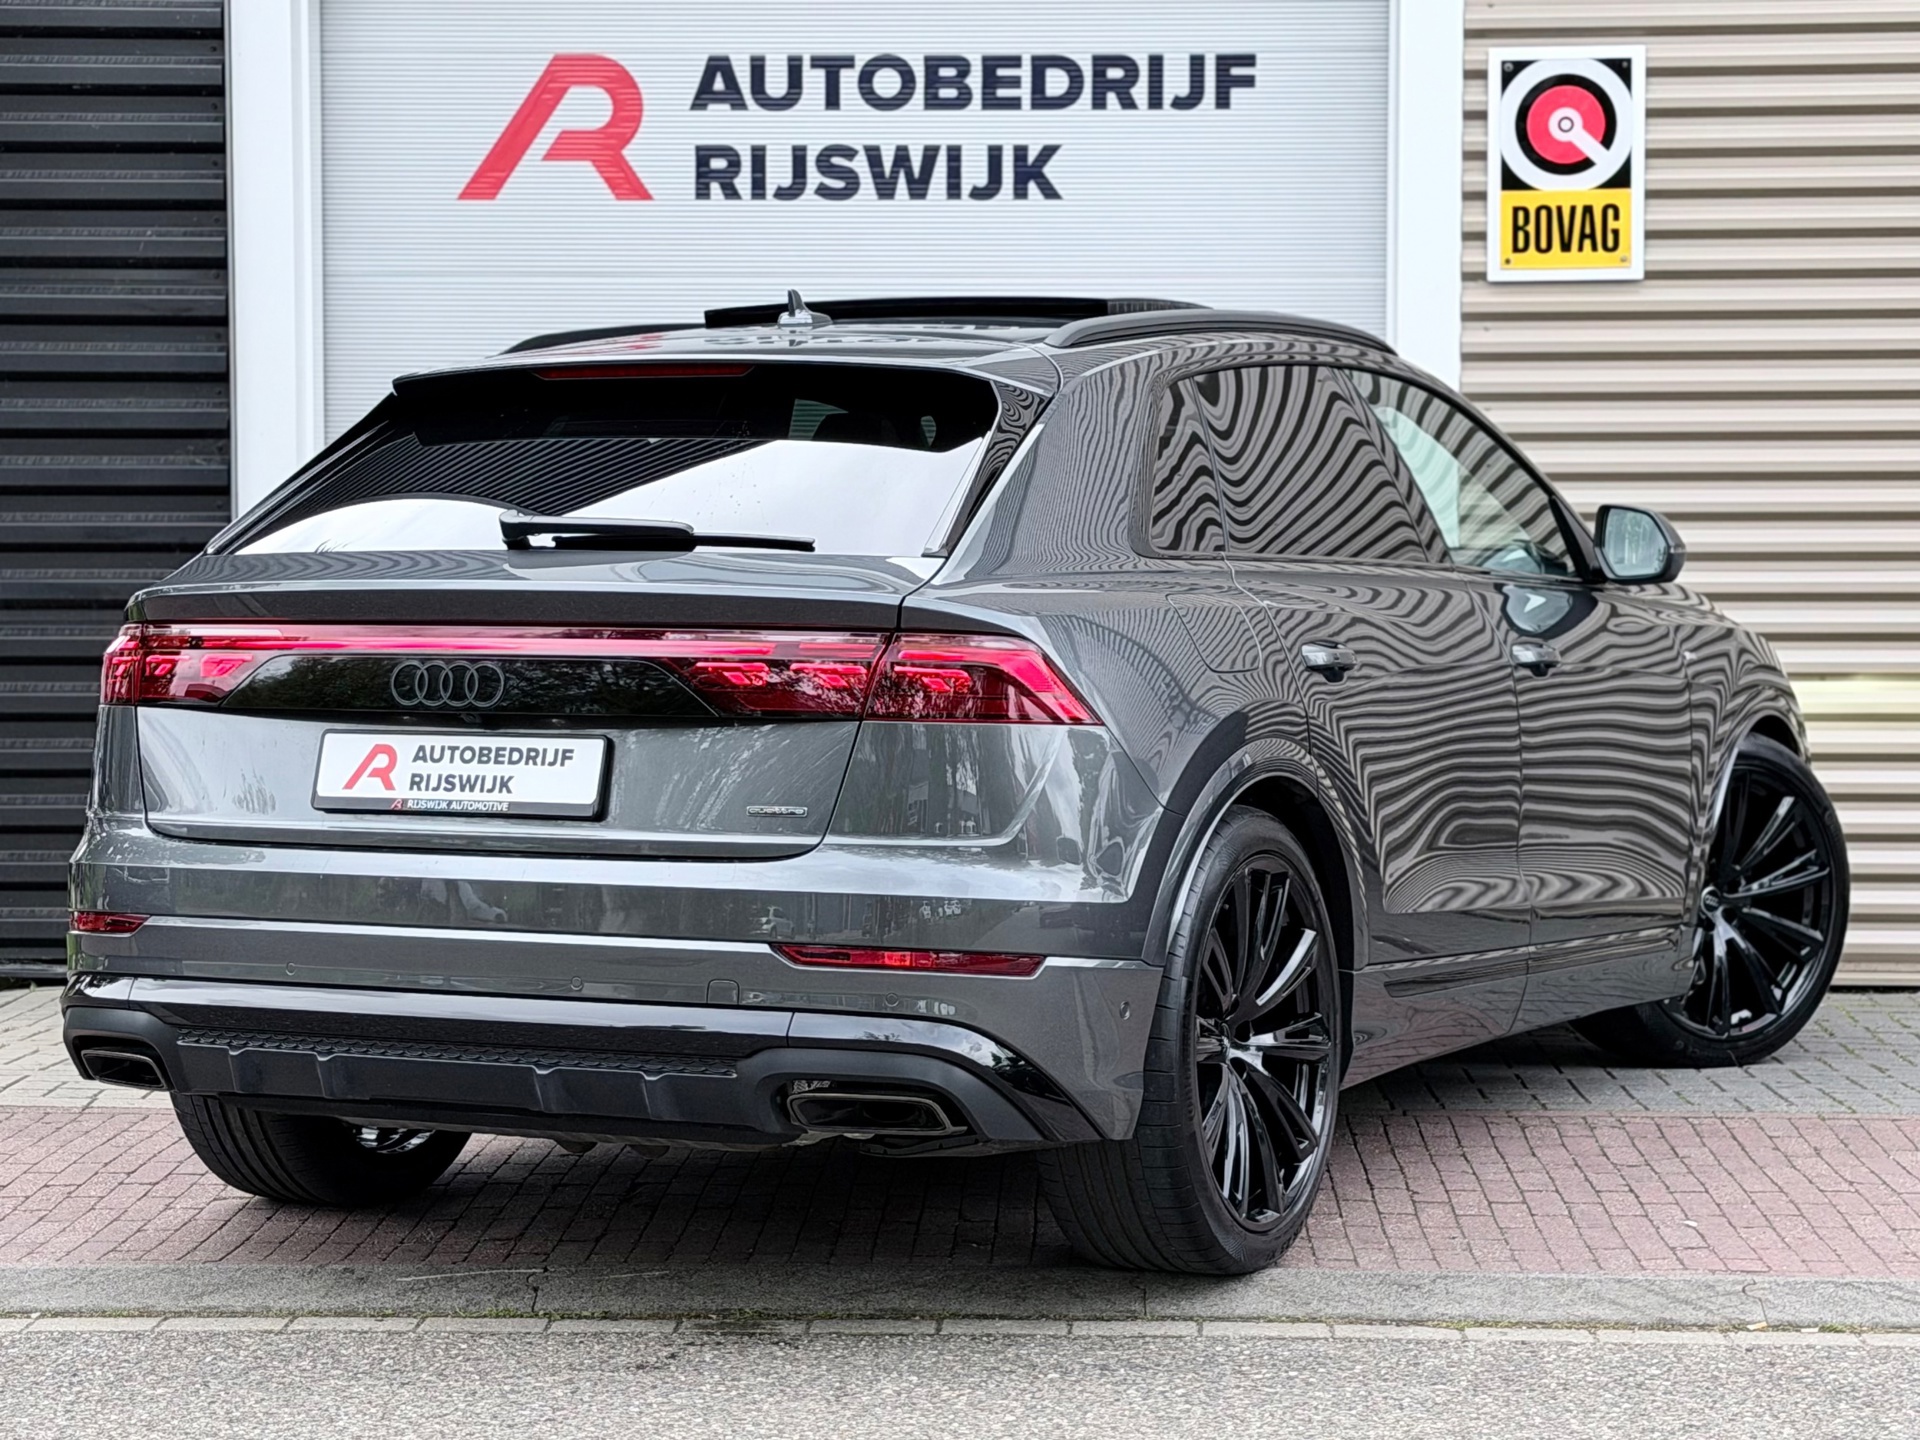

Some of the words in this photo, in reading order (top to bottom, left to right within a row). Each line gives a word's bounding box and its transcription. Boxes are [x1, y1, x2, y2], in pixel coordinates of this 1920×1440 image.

[690, 54, 1257, 111] AUTOBEDRIJF
[695, 144, 1064, 201] RIJSWIJK
[1512, 203, 1620, 253] BOVAG
[412, 745, 575, 767] AUTOBEDRIJF
[409, 773, 515, 794] RIJSWIJK
[407, 799, 449, 810] RIJSWIJK
[450, 801, 509, 811] AUTOMOTIVE
